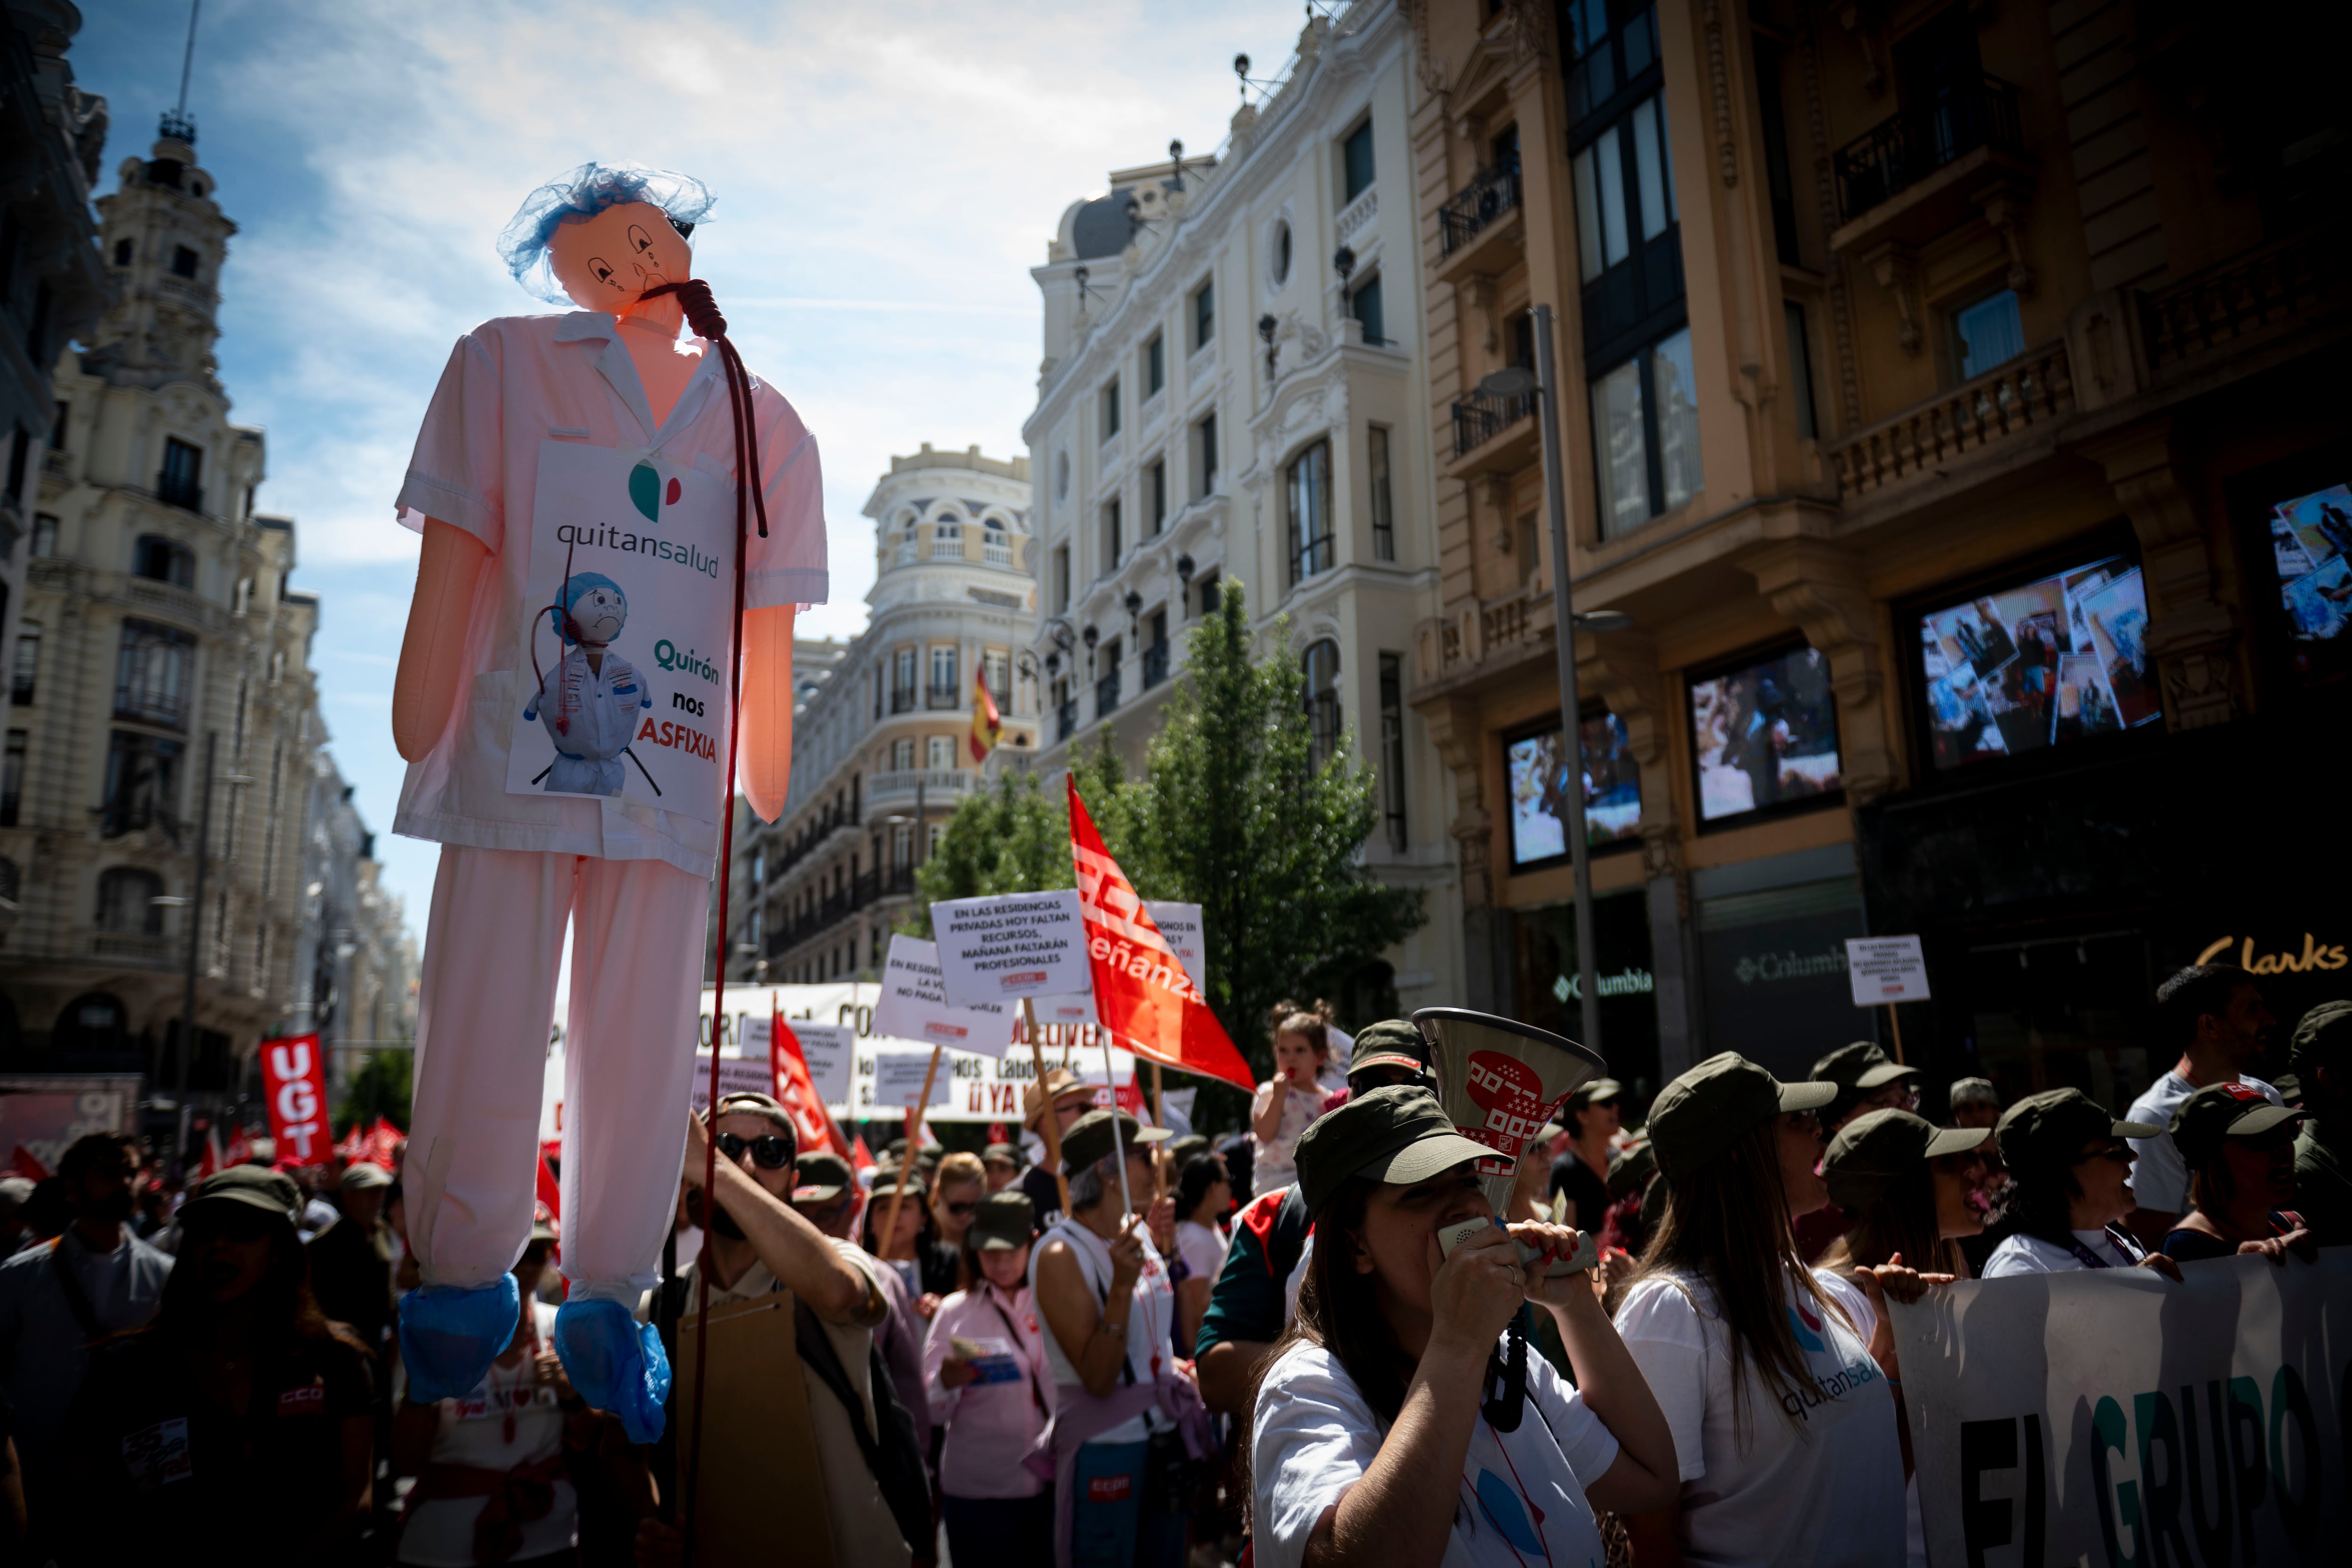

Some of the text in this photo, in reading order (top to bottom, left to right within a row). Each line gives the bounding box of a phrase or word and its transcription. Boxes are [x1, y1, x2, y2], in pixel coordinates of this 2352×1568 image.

[557, 522, 718, 579] quitansalud
[654, 639, 719, 685] Quirón
[673, 691, 704, 717] nos
[636, 717, 717, 764] ASFIXIA
[954, 900, 1061, 918] EN LAS RESIDENCIAS
[950, 912, 1070, 932] PRIVADAS HOY FALTAN
[1187, 923, 1196, 931] EN
[981, 929, 1042, 943] RECURSOS,
[962, 938, 1069, 959] MAÑANA FALTARÁN
[891, 959, 904, 968] EN
[975, 953, 1062, 971] PROFESIONALES
[1758, 944, 1848, 980] Columb
[918, 978, 931, 987] LA
[1571, 966, 1653, 1000] Clumbia
[897, 987, 914, 997] NO
[914, 990, 942, 1003] PAGA
[270, 1042, 319, 1160] UGT
[2091, 1364, 2321, 1568] GRUPO
